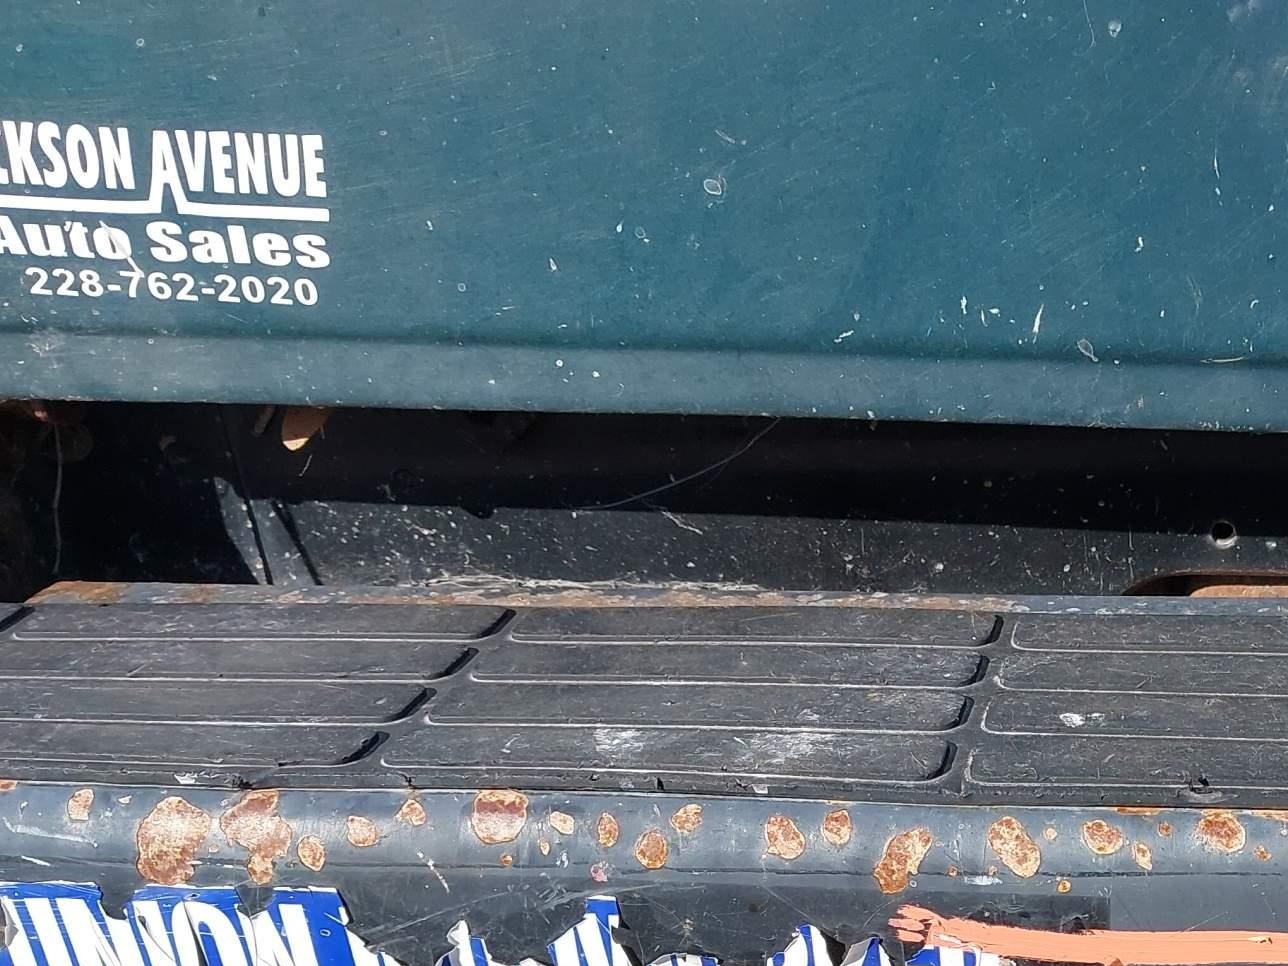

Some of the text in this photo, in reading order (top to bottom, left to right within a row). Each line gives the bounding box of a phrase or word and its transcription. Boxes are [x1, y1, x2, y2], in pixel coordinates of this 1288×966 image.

[148, 129, 328, 212] AVENUE
[0, 215, 330, 268] Auto Sales
[24, 266, 318, 306] 228-762-2020
